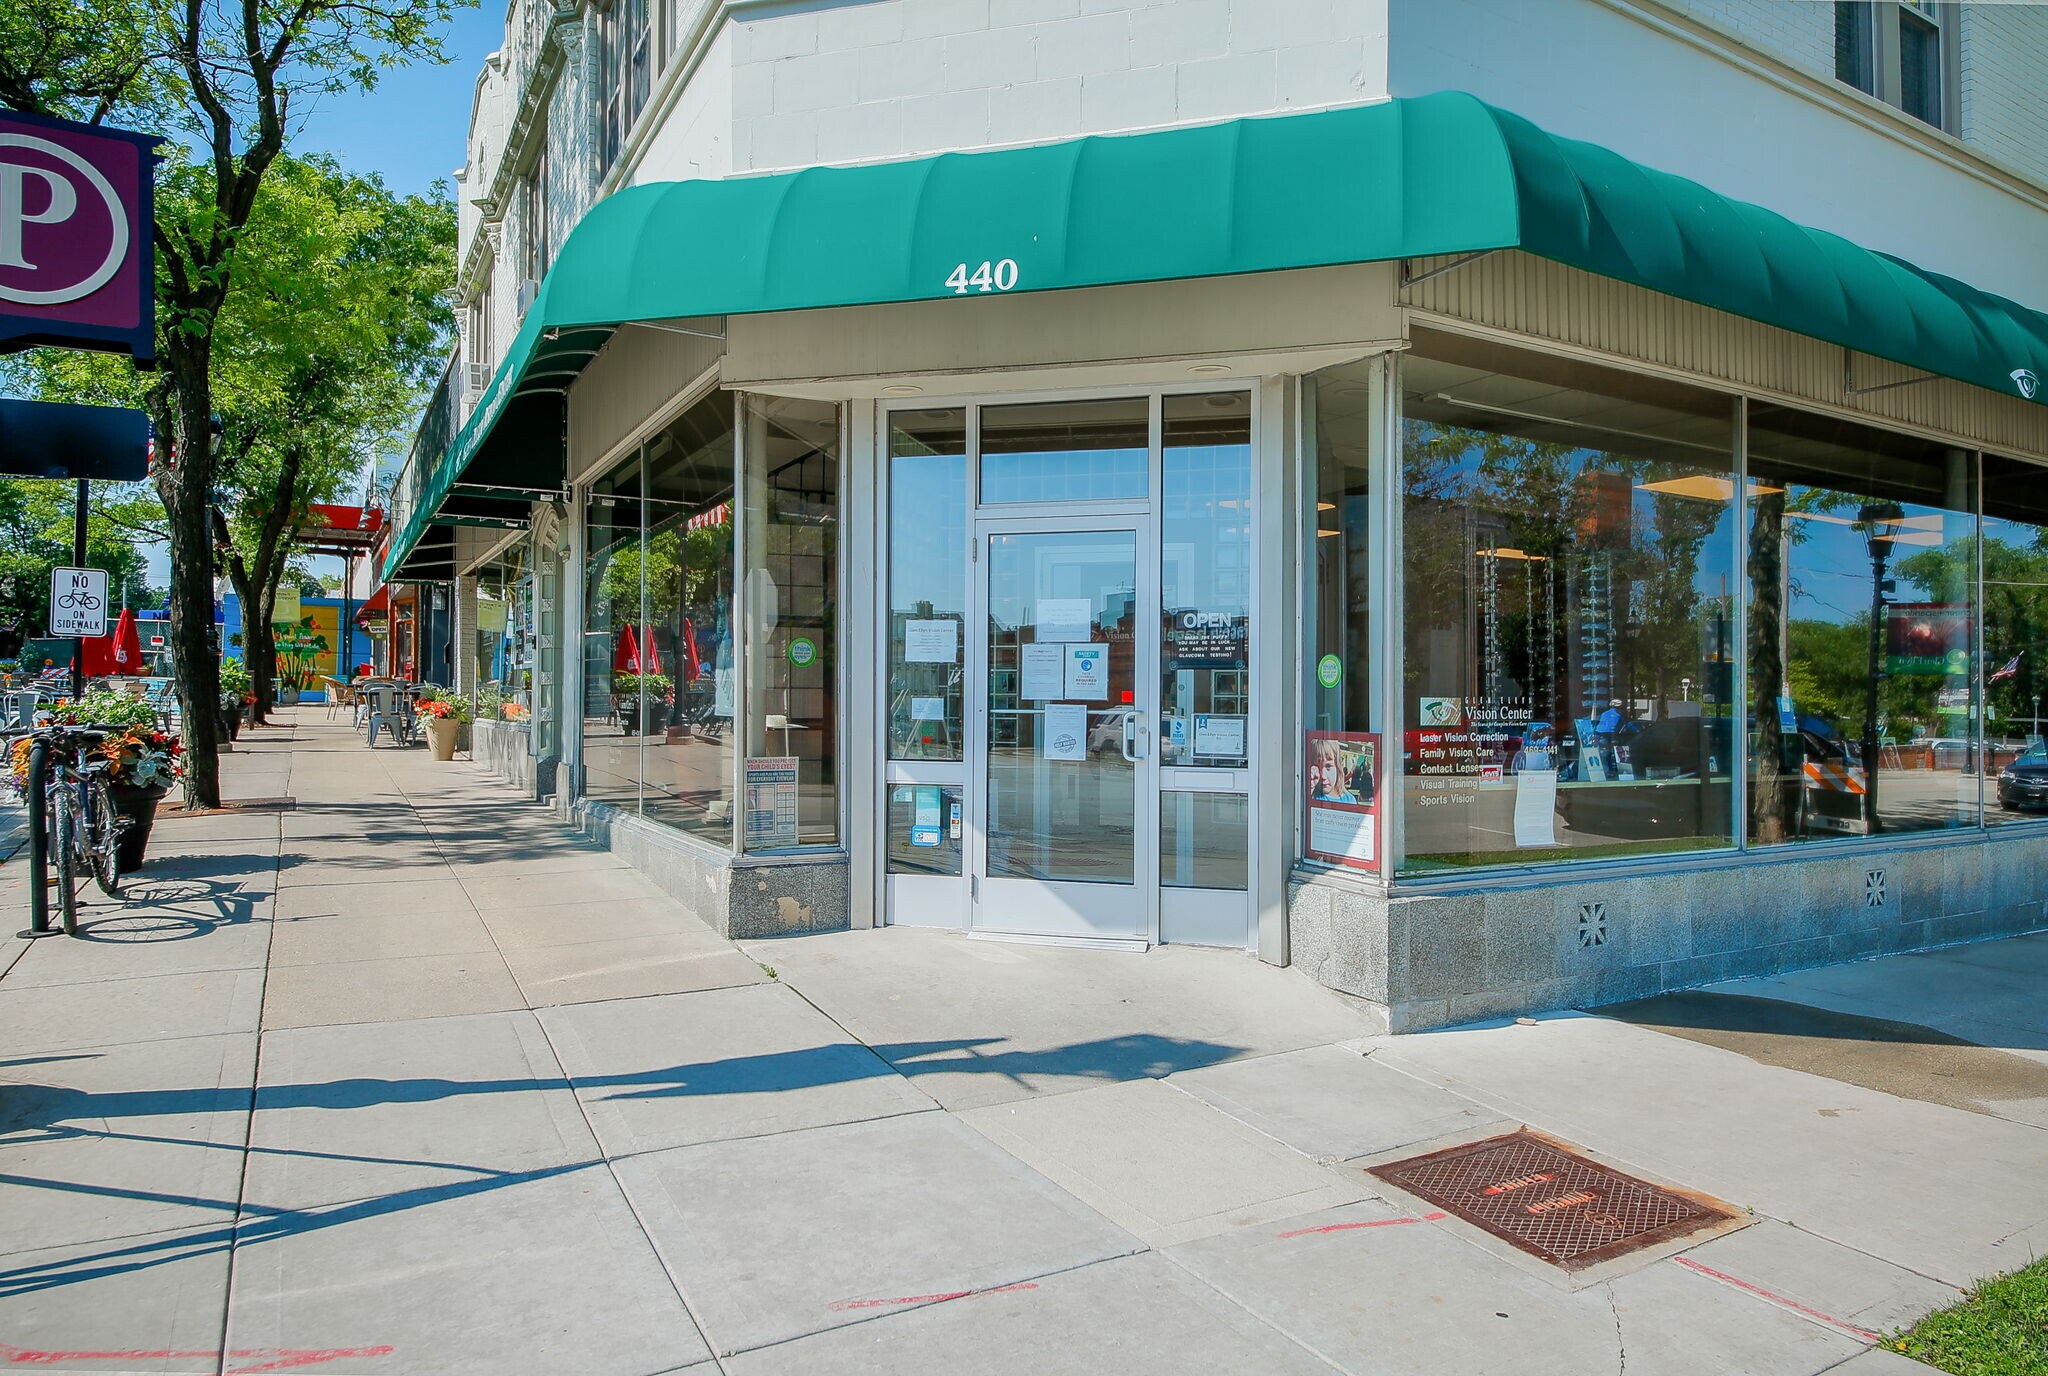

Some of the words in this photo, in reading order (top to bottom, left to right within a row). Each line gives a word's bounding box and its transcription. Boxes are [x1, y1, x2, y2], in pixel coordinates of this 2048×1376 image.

[0, 162, 77, 269] P
[945, 258, 1018, 294] 440
[72, 575, 88, 588] NO
[73, 611, 85, 619] ON
[1183, 612, 1232, 628] OPEN
[57, 620, 100, 630] SIDEWALK
[1105, 631, 1129, 639] Vision
[794, 644, 811, 652] think
[1465, 706, 1497, 719] Vision
[1500, 706, 1532, 720] Center
[1420, 733, 1441, 743] Laser
[1445, 732, 1467, 742] Vision
[1470, 732, 1508, 742] Correction
[1420, 748, 1445, 759] Family
[1449, 748, 1473, 757] Vision
[1476, 747, 1494, 757] Care
[1524, 745, 1558, 755] 469-4141
[1420, 764, 1453, 774] Contact
[1456, 763, 1483, 773] Lenses
[1420, 779, 1445, 789] Visual
[1447, 778, 1478, 790] Training
[1420, 795, 1448, 806] Sports
[1451, 794, 1475, 803] Vision
